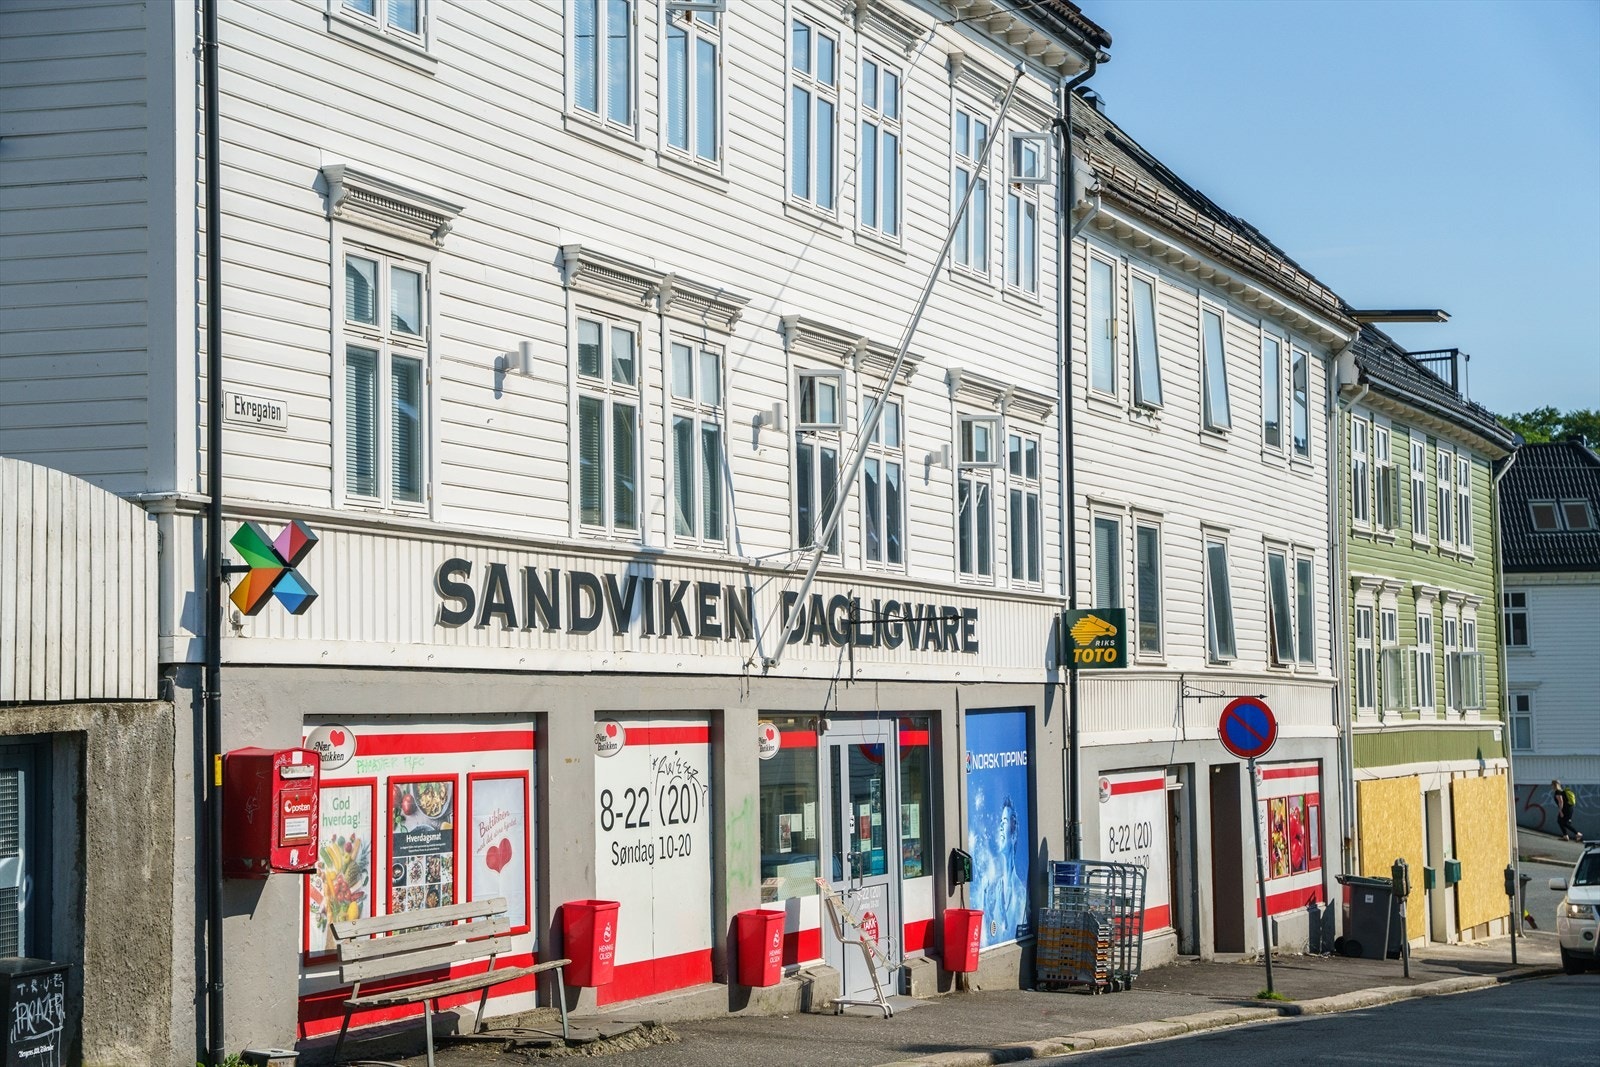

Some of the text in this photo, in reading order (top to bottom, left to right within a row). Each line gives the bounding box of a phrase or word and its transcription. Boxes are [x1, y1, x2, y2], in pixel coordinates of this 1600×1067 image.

[234, 395, 281, 422] Ekregaten
[435, 557, 979, 654] SANDVIKEN DAGLIGVARE
[1095, 639, 1116, 647] RIKS
[1073, 647, 1117, 663] TOTO
[972, 750, 1028, 770] NORSK TIPPING
[291, 803, 311, 814] posten
[332, 795, 351, 811] God
[600, 782, 699, 832] 8-22 (20)
[322, 812, 361, 830] hverdag!
[479, 807, 511, 838] Butikken
[406, 832, 442, 844] Hverdagsmat
[1109, 821, 1153, 854] 8-22 (20)
[611, 833, 692, 867] Søndag 10-20
